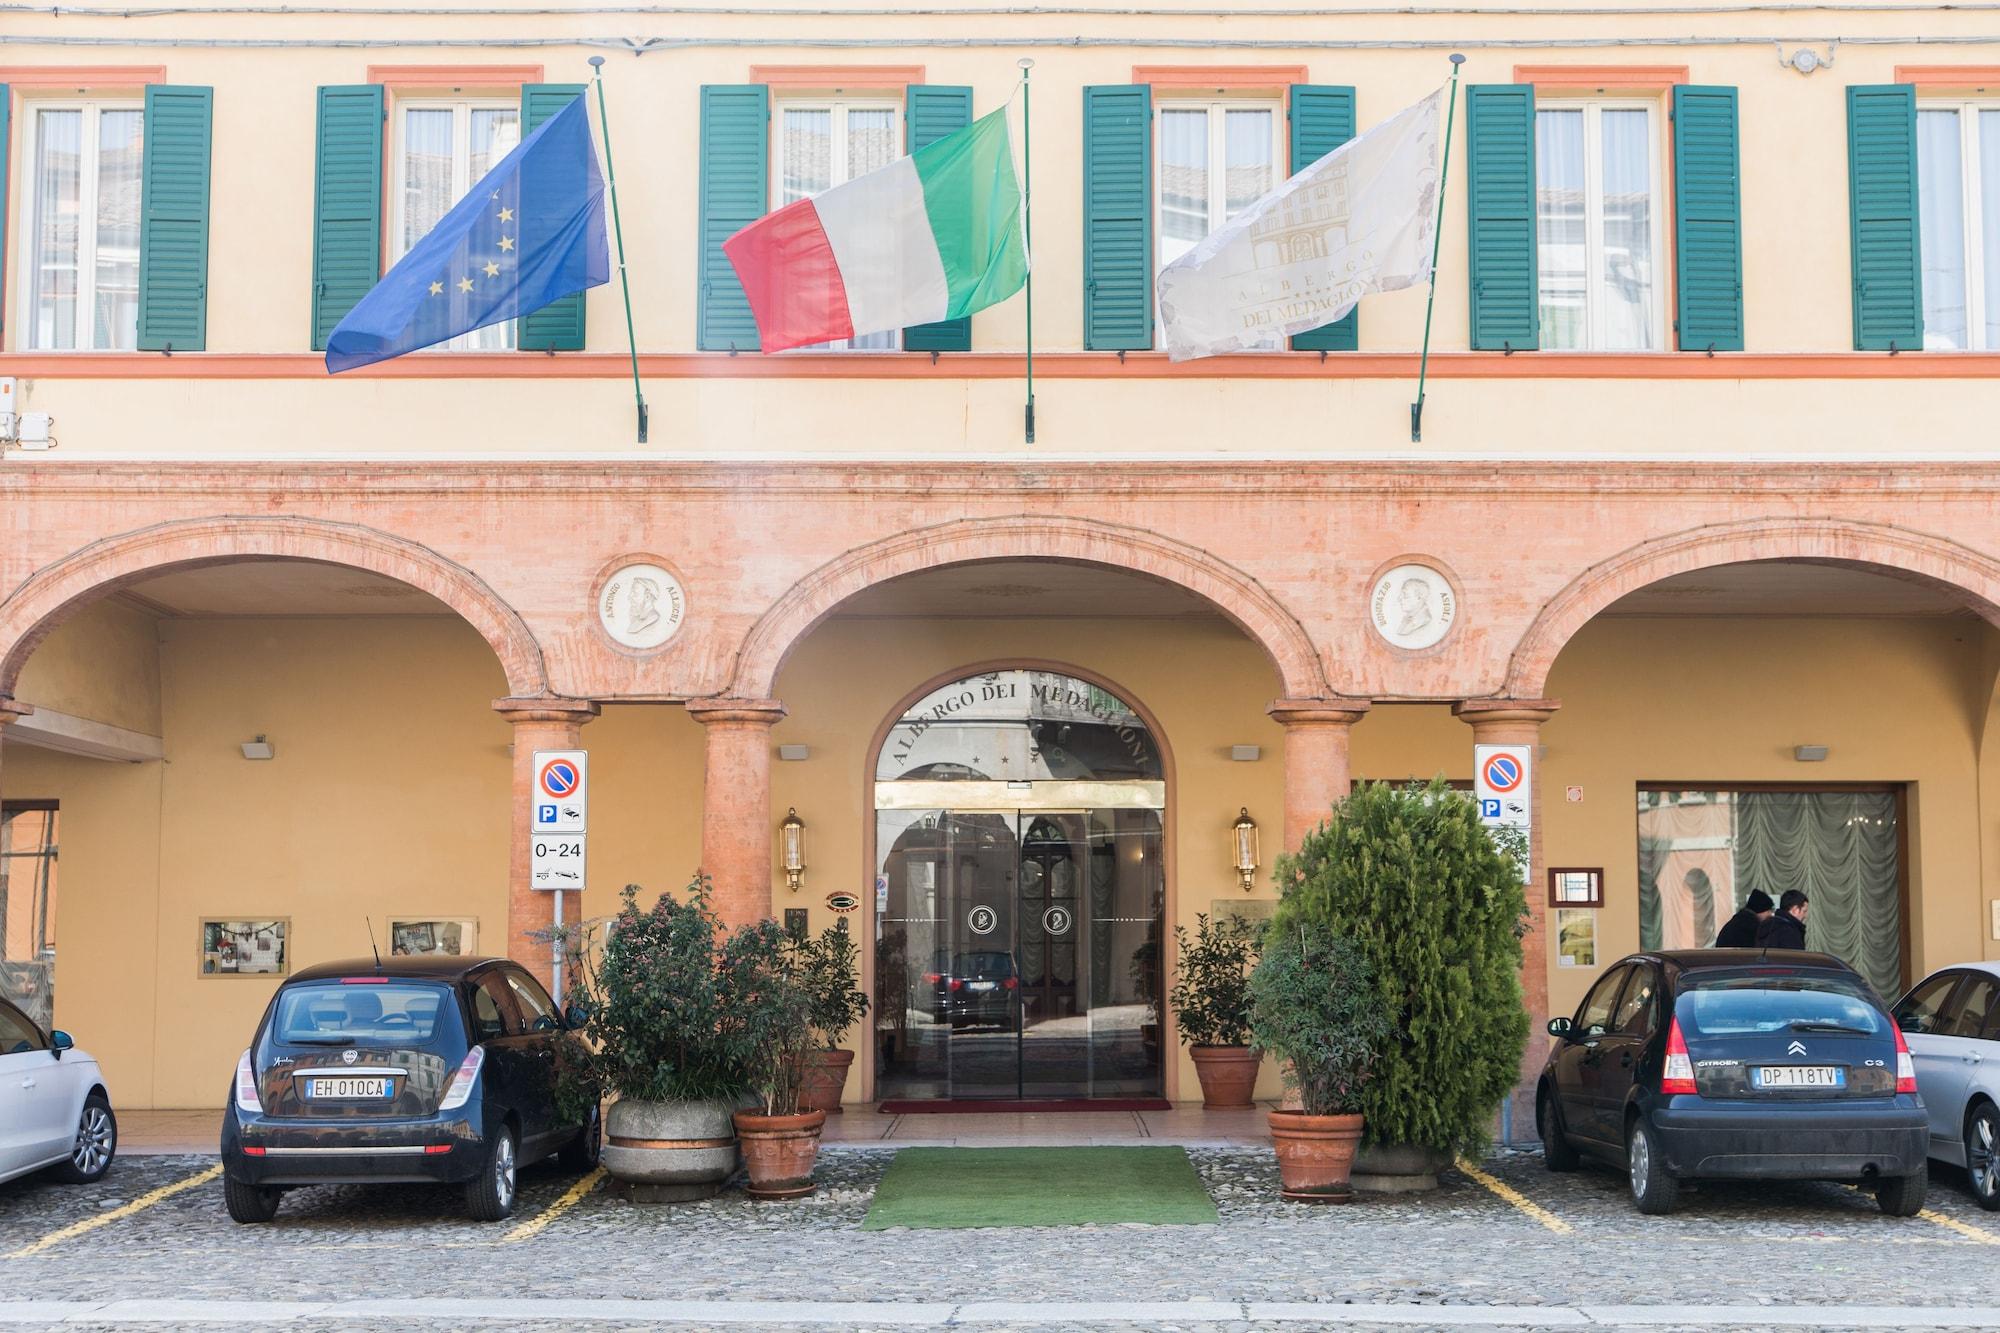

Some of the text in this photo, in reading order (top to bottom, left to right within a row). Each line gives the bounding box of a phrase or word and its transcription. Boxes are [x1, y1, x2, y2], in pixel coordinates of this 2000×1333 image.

[1243, 309, 1273, 328] DEI
[892, 683, 1149, 767] ALBERGO DEI MEDAGLIONI
[542, 806, 555, 822] P
[1485, 800, 1499, 816] P
[1864, 1059, 1885, 1067] C3
[1763, 1068, 1833, 1084] DP 118TV
[315, 1080, 333, 1096] EH
[338, 1080, 383, 1095] 010CA
